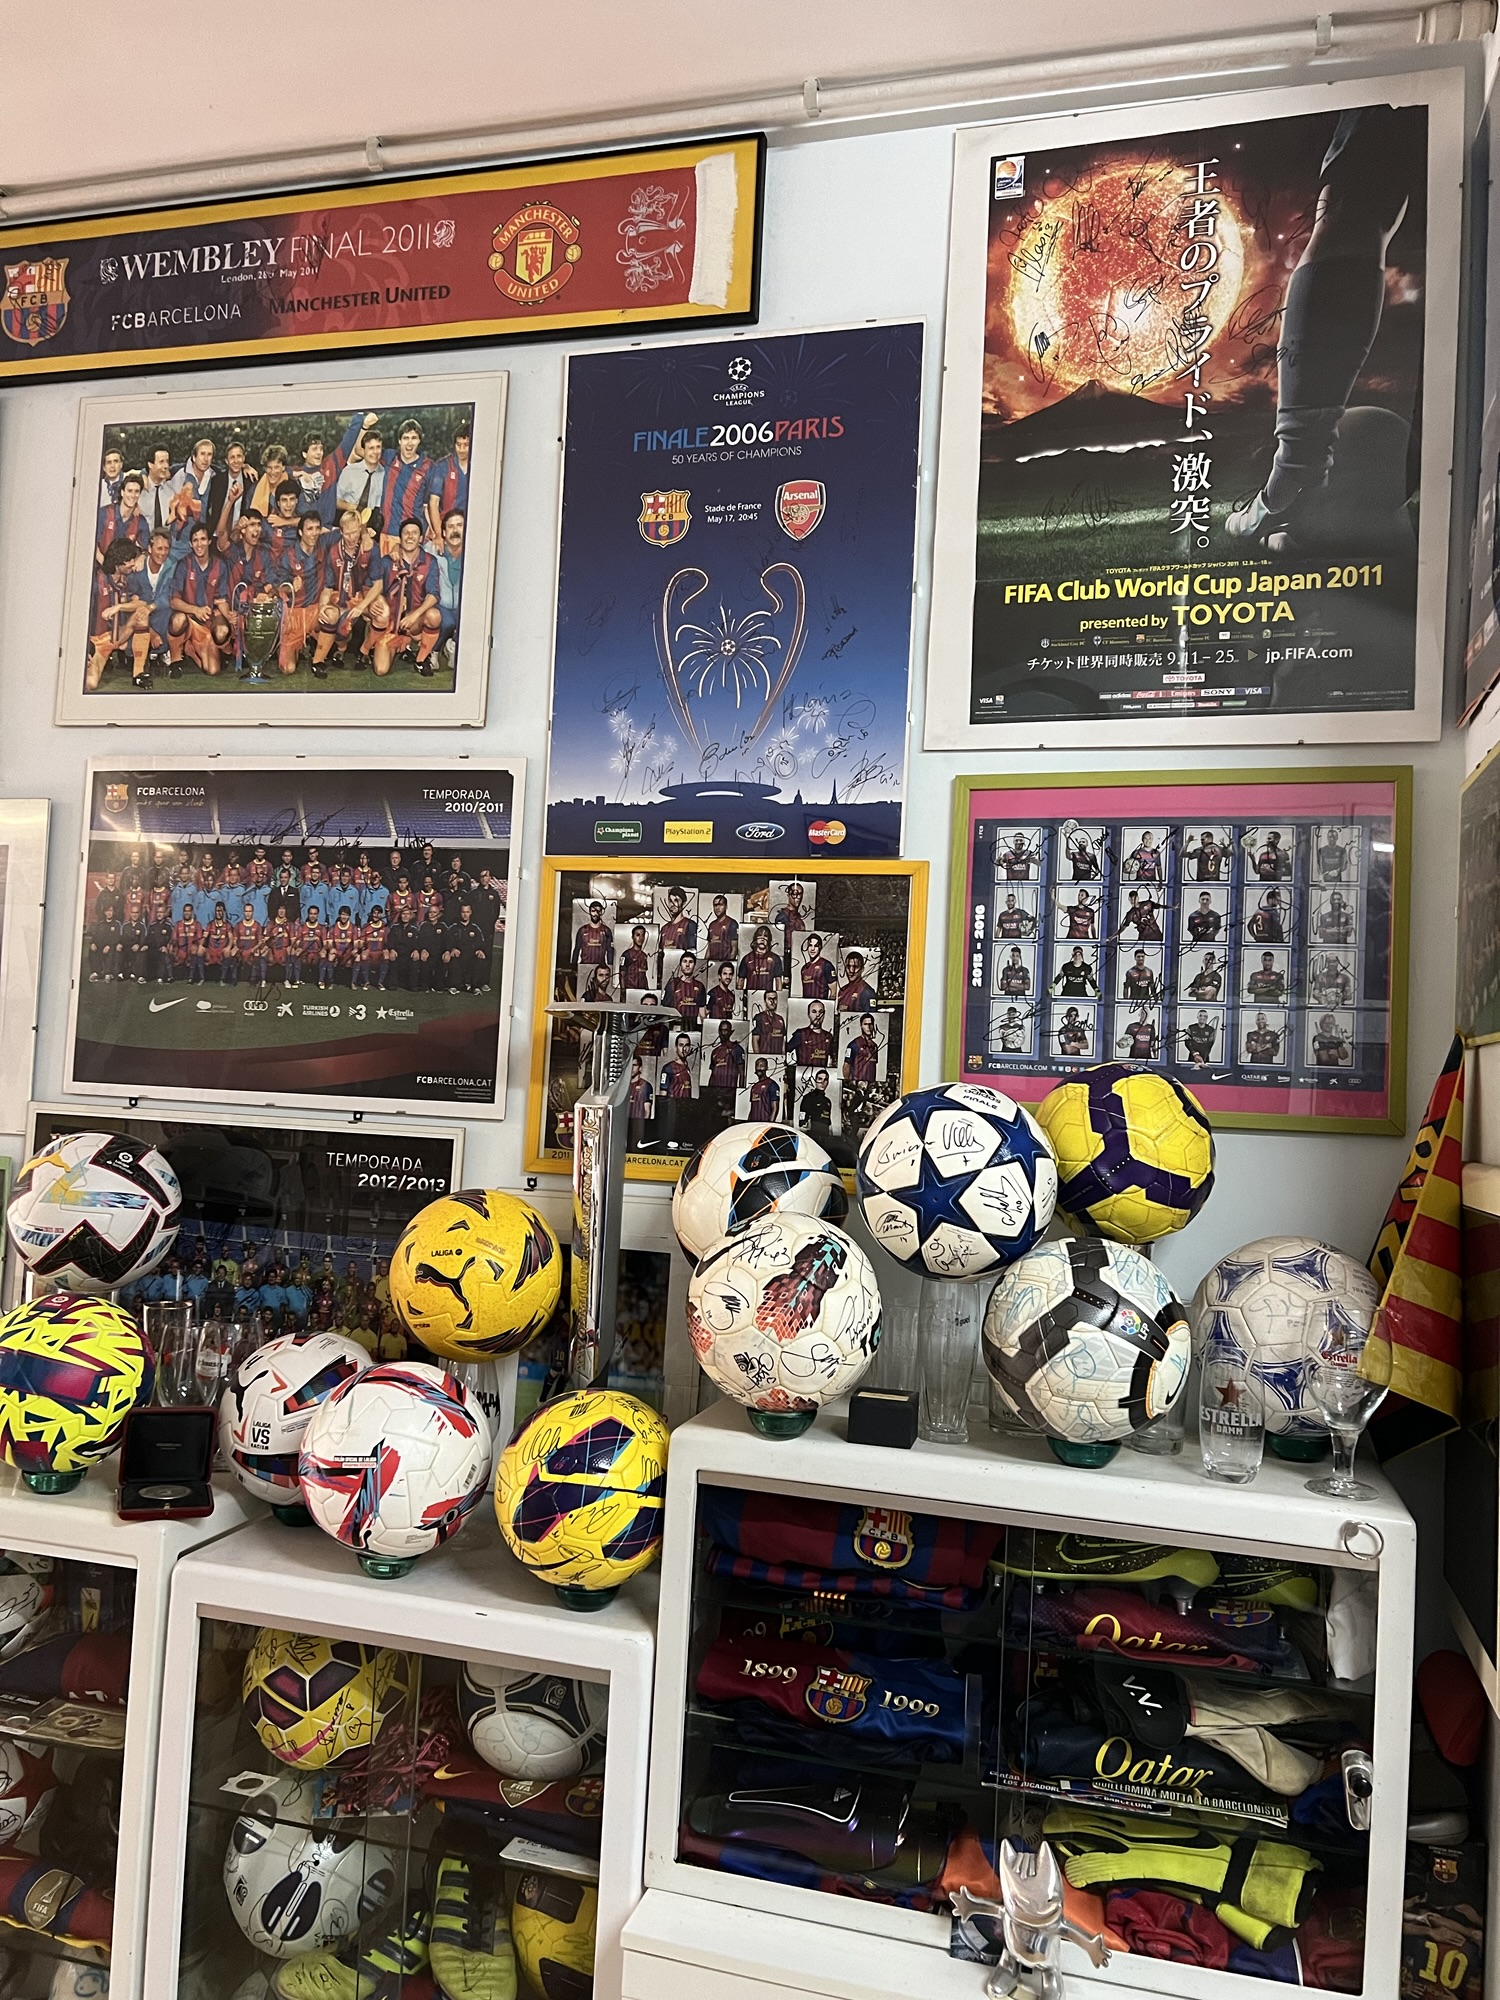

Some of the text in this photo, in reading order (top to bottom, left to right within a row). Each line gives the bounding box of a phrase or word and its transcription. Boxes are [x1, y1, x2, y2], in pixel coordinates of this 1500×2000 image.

[499, 209, 573, 245] MANCHESTER
[121, 223, 430, 281] WEMBLEY FINAL 2011
[221, 273, 256, 284] London,
[279, 268, 297, 279] May
[300, 266, 318, 276] 2011
[507, 278, 559, 298] UNITED
[269, 285, 451, 314] MANCHESTER UNITED
[111, 304, 241, 331] FCBARCELONA
[713, 390, 765, 401] CHAMPIONS
[671, 446, 802, 465] 50 YEARS OF CHAMPIONS
[783, 490, 818, 500] Arsenal
[705, 502, 762, 513] Stade de France
[707, 513, 758, 525] May 17, 20:45
[1004, 565, 1383, 604] FIFA Club World Cup Japan 2011
[1079, 601, 1295, 632] presented by TOYOTA
[1027, 652, 1163, 671] チケット世界同時販売
[1265, 647, 1353, 664] jp.FIFA.com
[137, 787, 205, 796] FCBARCELONA
[423, 789, 491, 799] TEMPORADA
[445, 801, 503, 813] 2010/2011
[744, 825, 775, 838] Ford
[808, 828, 846, 837] MasterCard
[388, 1009, 414, 1018] Estrella
[988, 1063, 1048, 1071] FCBARCELONA.COM
[416, 1076, 492, 1087] FCBARCELONA.CAT
[326, 1152, 423, 1172] TEMPORADA
[625, 1157, 684, 1167] ARCELONA.CAT
[358, 1174, 446, 1192] 2012/2013
[1138, 1322, 1150, 1341] LFP
[1200, 1407, 1263, 1428] ESTRELLA
[252, 1428, 270, 1444] VS
[1216, 1425, 1243, 1436] DAMM
[739, 1659, 797, 1684] 1899
[878, 1688, 940, 1719] 1999
[1095, 1736, 1214, 1788] Qatar
[510, 1783, 531, 1792] FIFA
[1160, 1790, 1194, 1804] MOTTA
[1199, 1795, 1210, 1806] LA
[1212, 1797, 1282, 1818] BARCELONISTA
[32, 1902, 48, 1915] FIFA
[1418, 1941, 1469, 1990] 10
